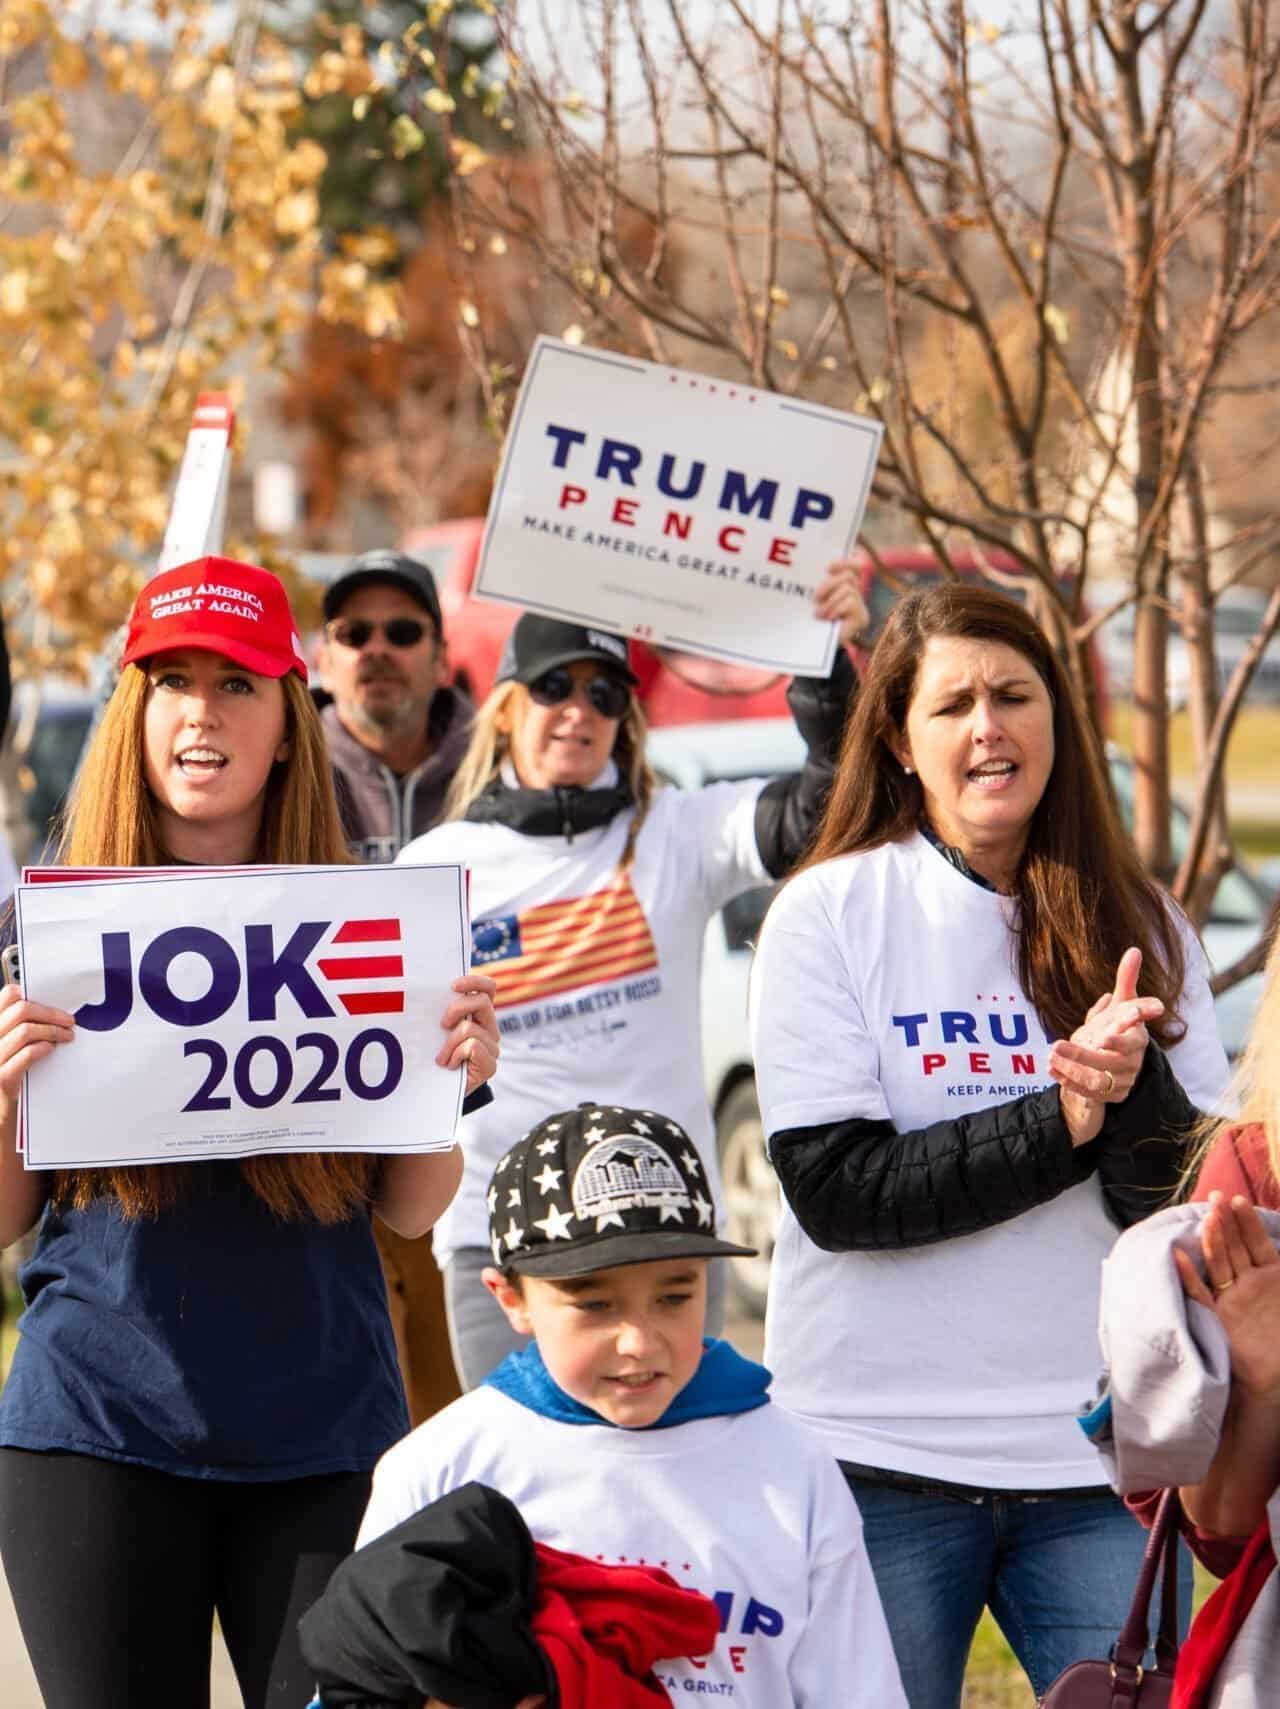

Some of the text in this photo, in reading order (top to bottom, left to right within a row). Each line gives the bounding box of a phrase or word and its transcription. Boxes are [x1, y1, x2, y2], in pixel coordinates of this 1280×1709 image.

[545, 423, 836, 530] TRUMP
[523, 515, 576, 541] MAKE
[583, 531, 670, 564] AMERICA
[677, 555, 740, 581] GREAT
[558, 484, 798, 567] PENCE
[150, 583, 264, 613] MAKE AMERICA
[151, 599, 258, 622] GREAT AGAIN
[74, 917, 405, 1032] JOKE
[892, 1011, 1056, 1048] TRU
[181, 1028, 404, 1113] 2020
[922, 1052, 1037, 1076] PEN
[947, 1085, 983, 1097] KEEP
